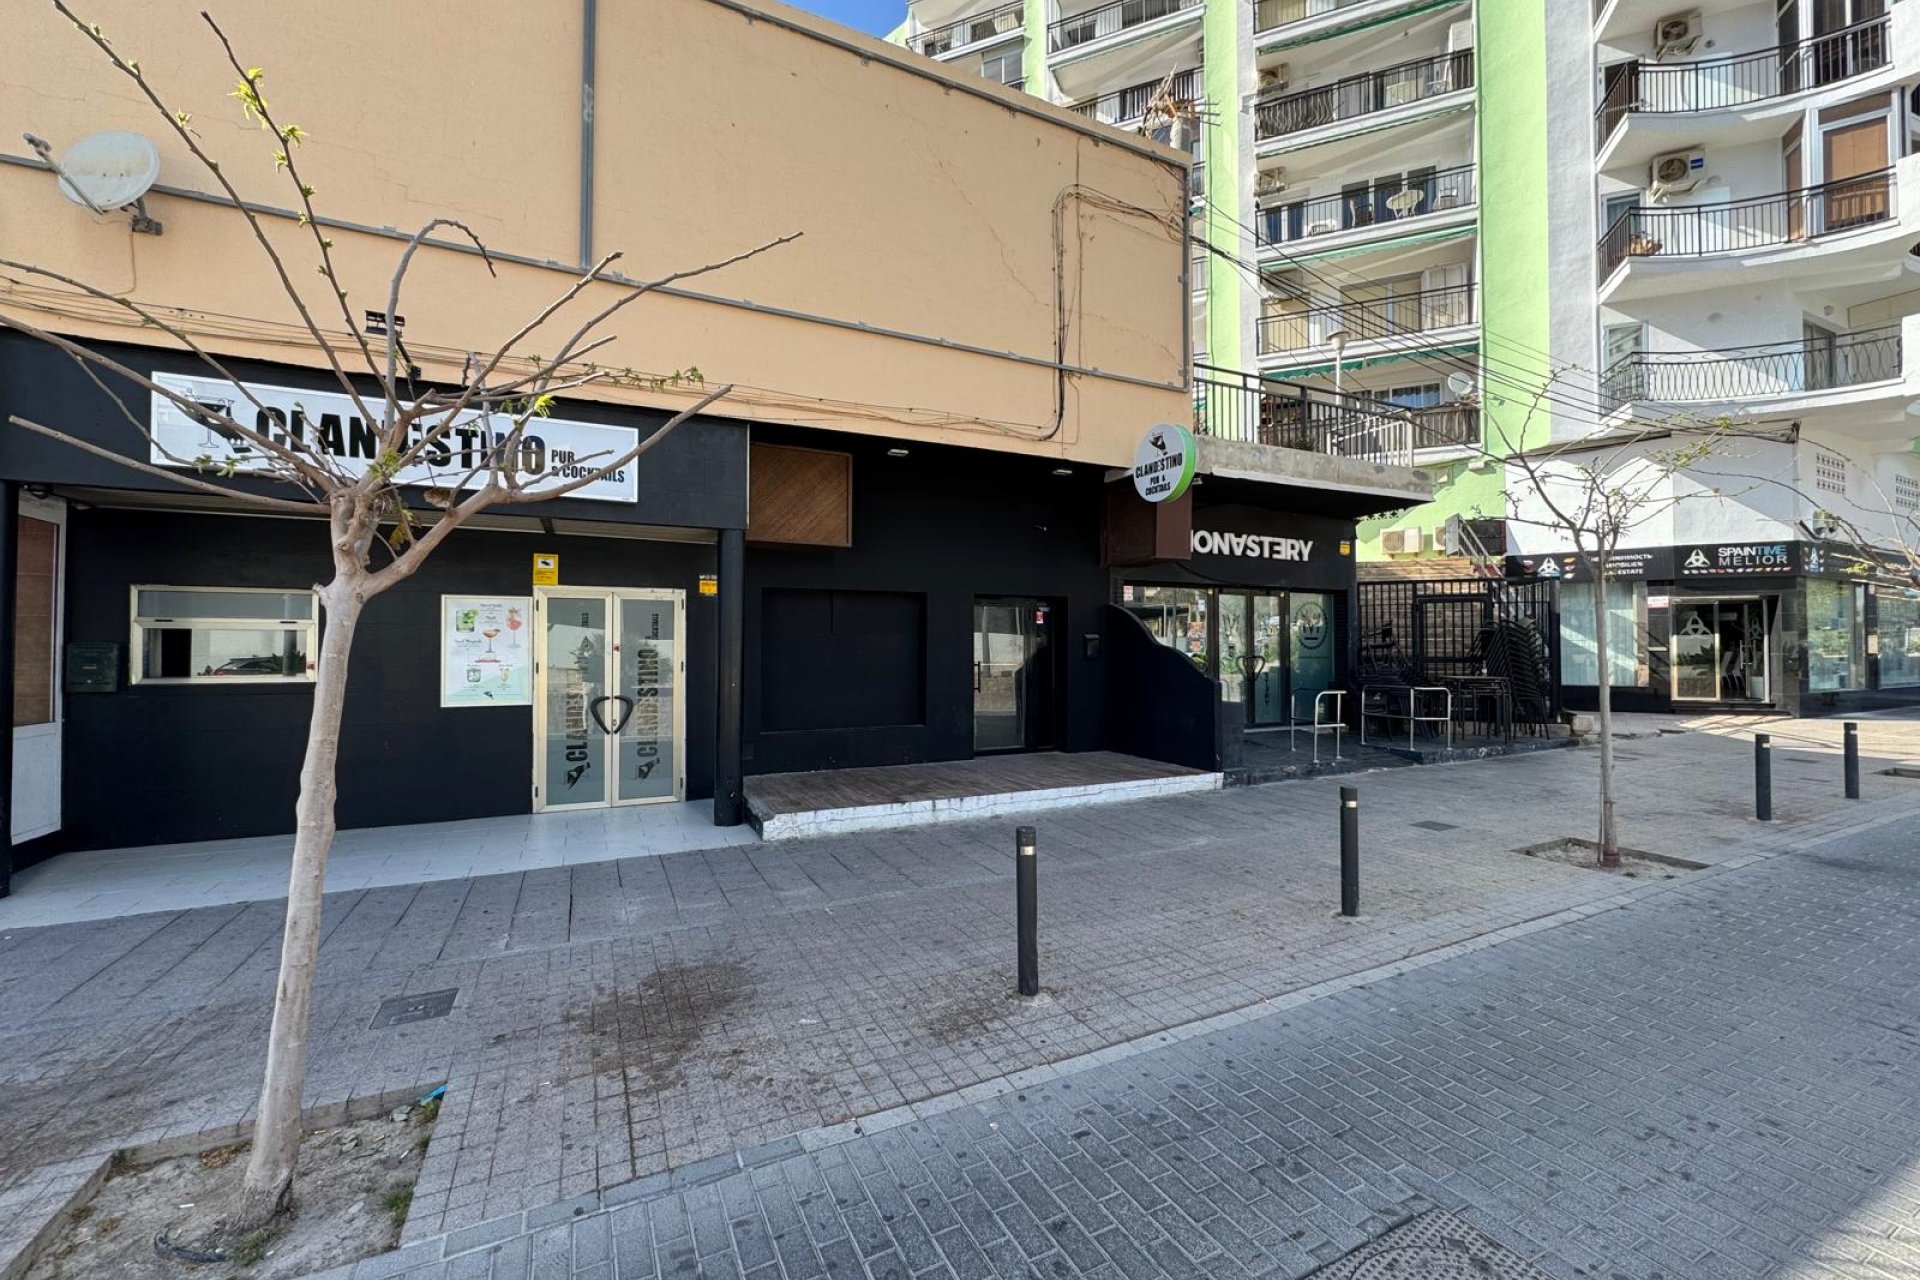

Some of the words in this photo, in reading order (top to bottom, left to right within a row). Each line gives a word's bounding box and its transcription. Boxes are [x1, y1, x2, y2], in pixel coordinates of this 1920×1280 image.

[257, 406, 545, 474] CLANESTINO
[1135, 452, 1183, 479] CLANDESTINO
[1191, 529, 1314, 562] ONASTERY
[1718, 555, 1788, 566] MELIOR
